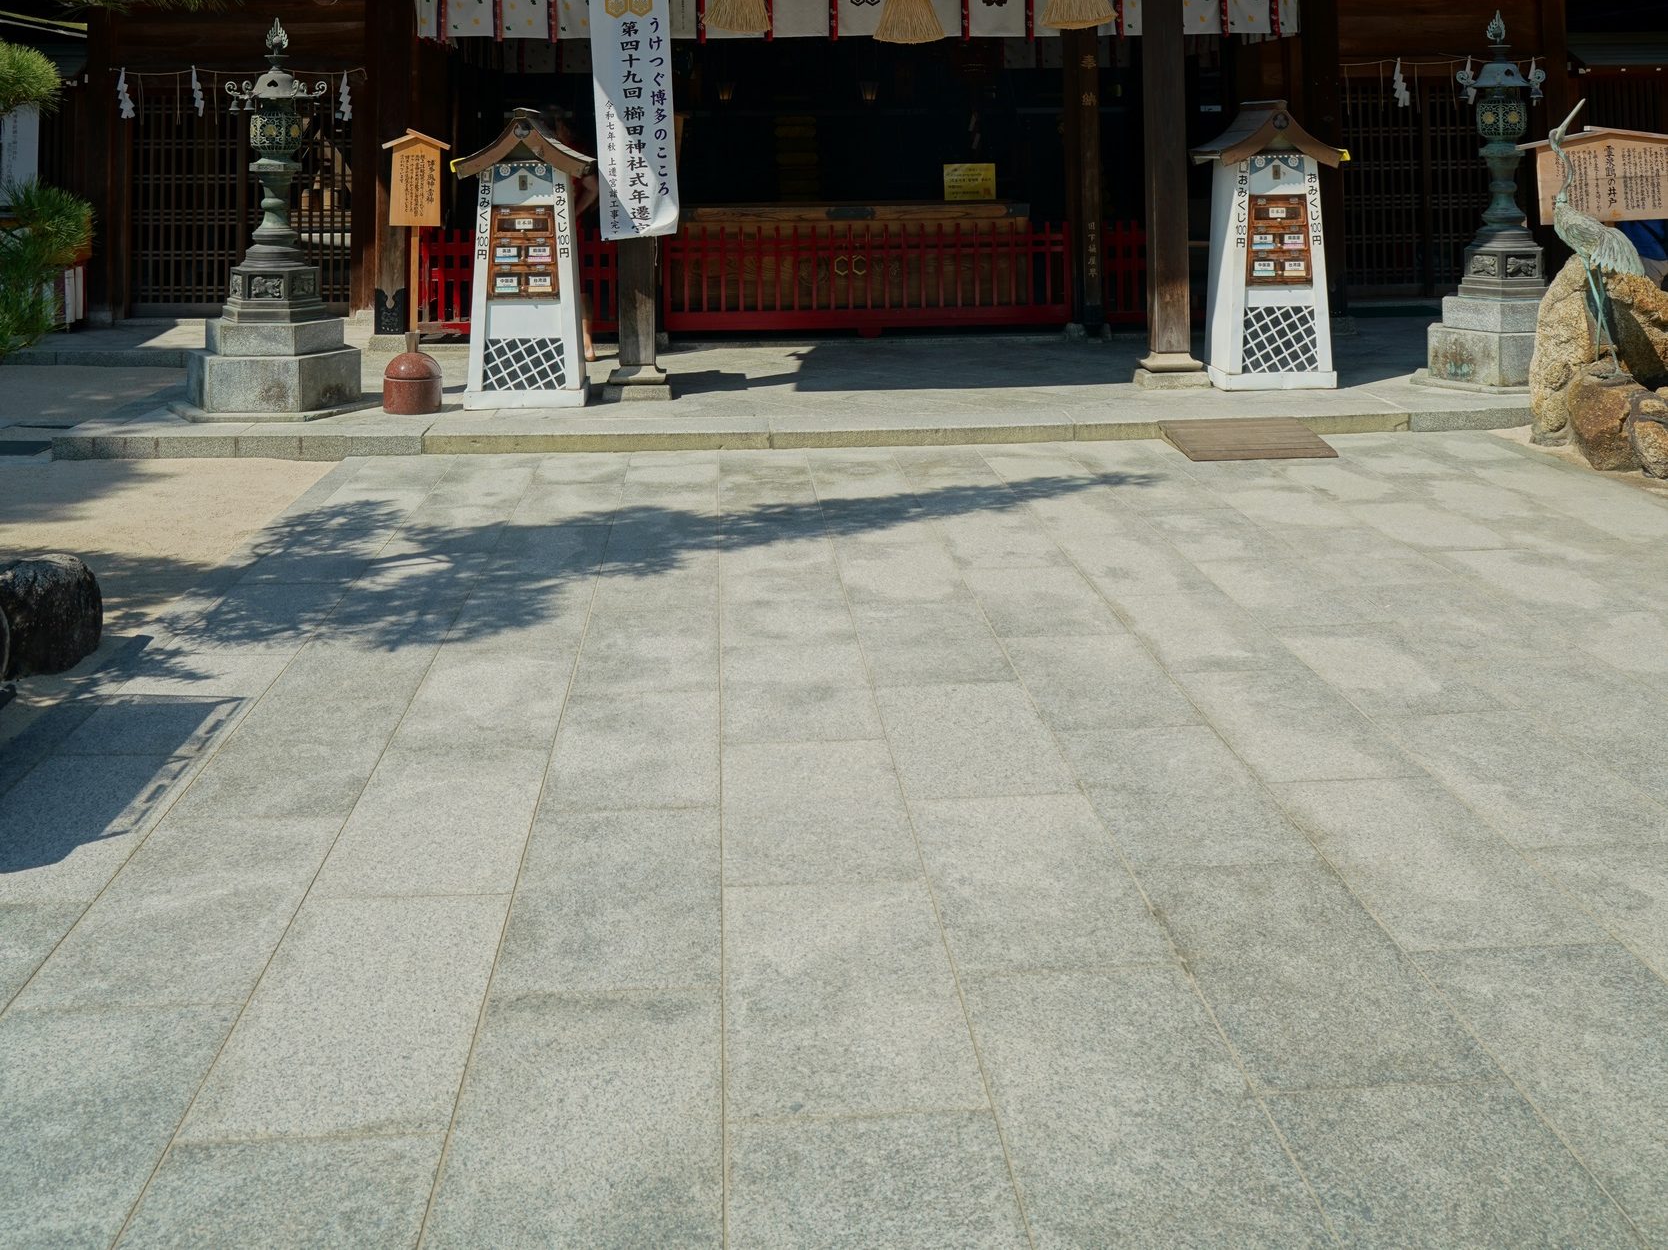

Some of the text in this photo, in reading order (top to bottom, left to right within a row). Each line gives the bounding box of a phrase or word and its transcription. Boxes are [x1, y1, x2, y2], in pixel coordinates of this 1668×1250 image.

[620, 21, 643, 99] 第四十九回
[604, 100, 616, 152] 令和七年秋
[648, 17, 670, 196] うけつぐ博多のこころ
[477, 183, 492, 260] おみくじ100円
[554, 182, 570, 259] おみくじ100円
[1236, 174, 1248, 248] おみくじ100円
[1307, 173, 1322, 246] おみくじ100円
